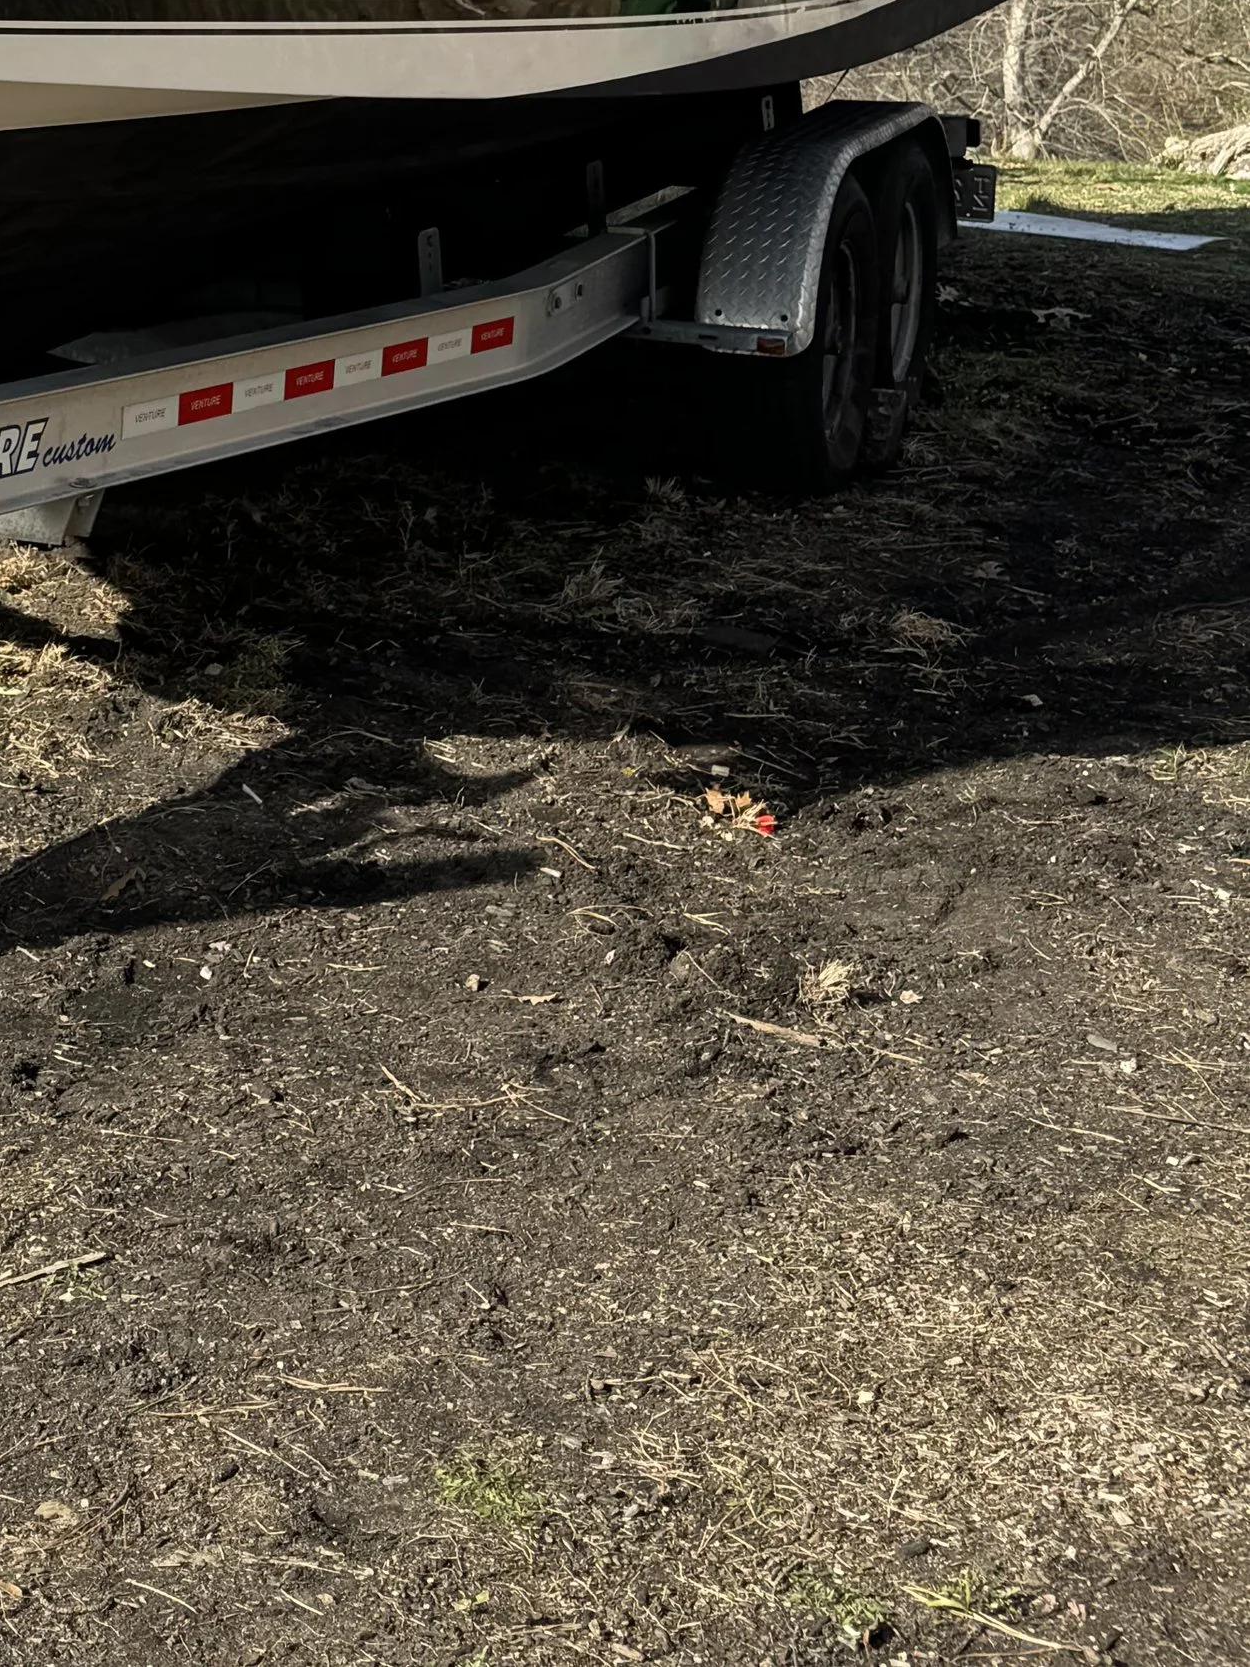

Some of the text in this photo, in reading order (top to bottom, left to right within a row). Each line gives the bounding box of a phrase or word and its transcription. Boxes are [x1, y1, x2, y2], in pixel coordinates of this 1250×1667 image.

[135, 407, 167, 424] VENTURE
[190, 394, 222, 411] VENTURE
[244, 383, 273, 398] VENTURE
[296, 370, 325, 386] VENTURE
[42, 432, 117, 468] custom
